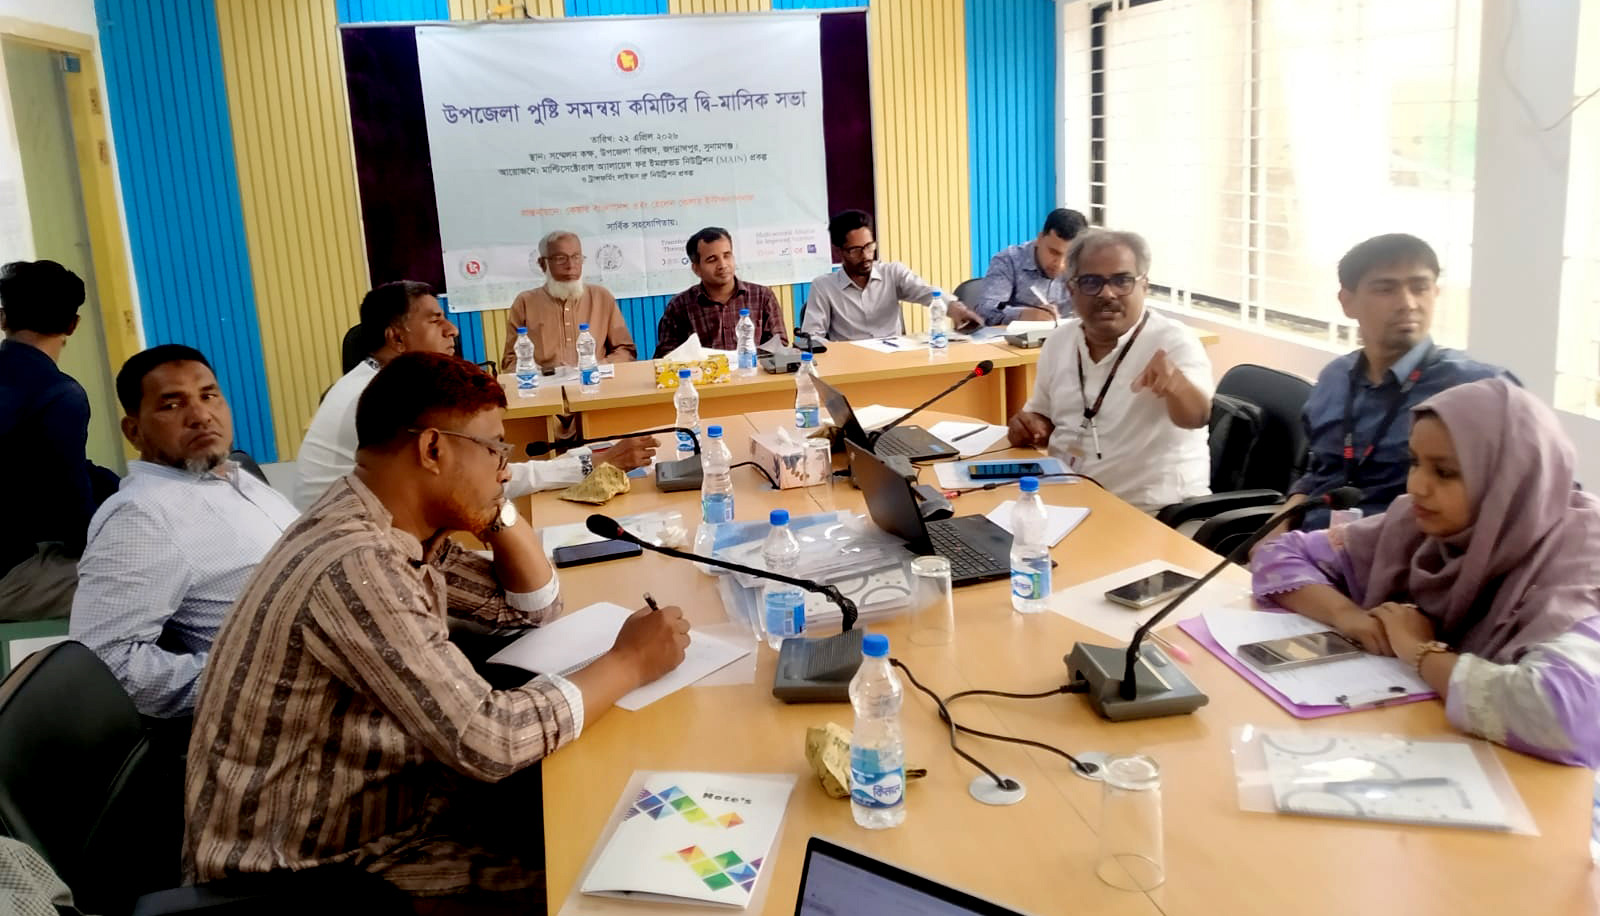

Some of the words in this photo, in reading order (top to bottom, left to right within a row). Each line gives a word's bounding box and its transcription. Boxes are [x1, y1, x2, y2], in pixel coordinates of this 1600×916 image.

[442, 103, 520, 124] উপজেলা
[527, 97, 559, 125] পুষ্টি
[565, 100, 621, 119] সমন্বয়
[626, 92, 688, 116] কমিটির
[694, 88, 769, 112] দ্বি-মাসিক
[774, 90, 807, 109] সভা
[633, 131, 653, 141] এপ্রিল
[600, 147, 631, 157] উপজেলা
[716, 154, 747, 166] (MAIN)
[607, 220, 629, 231] সার্বিক
